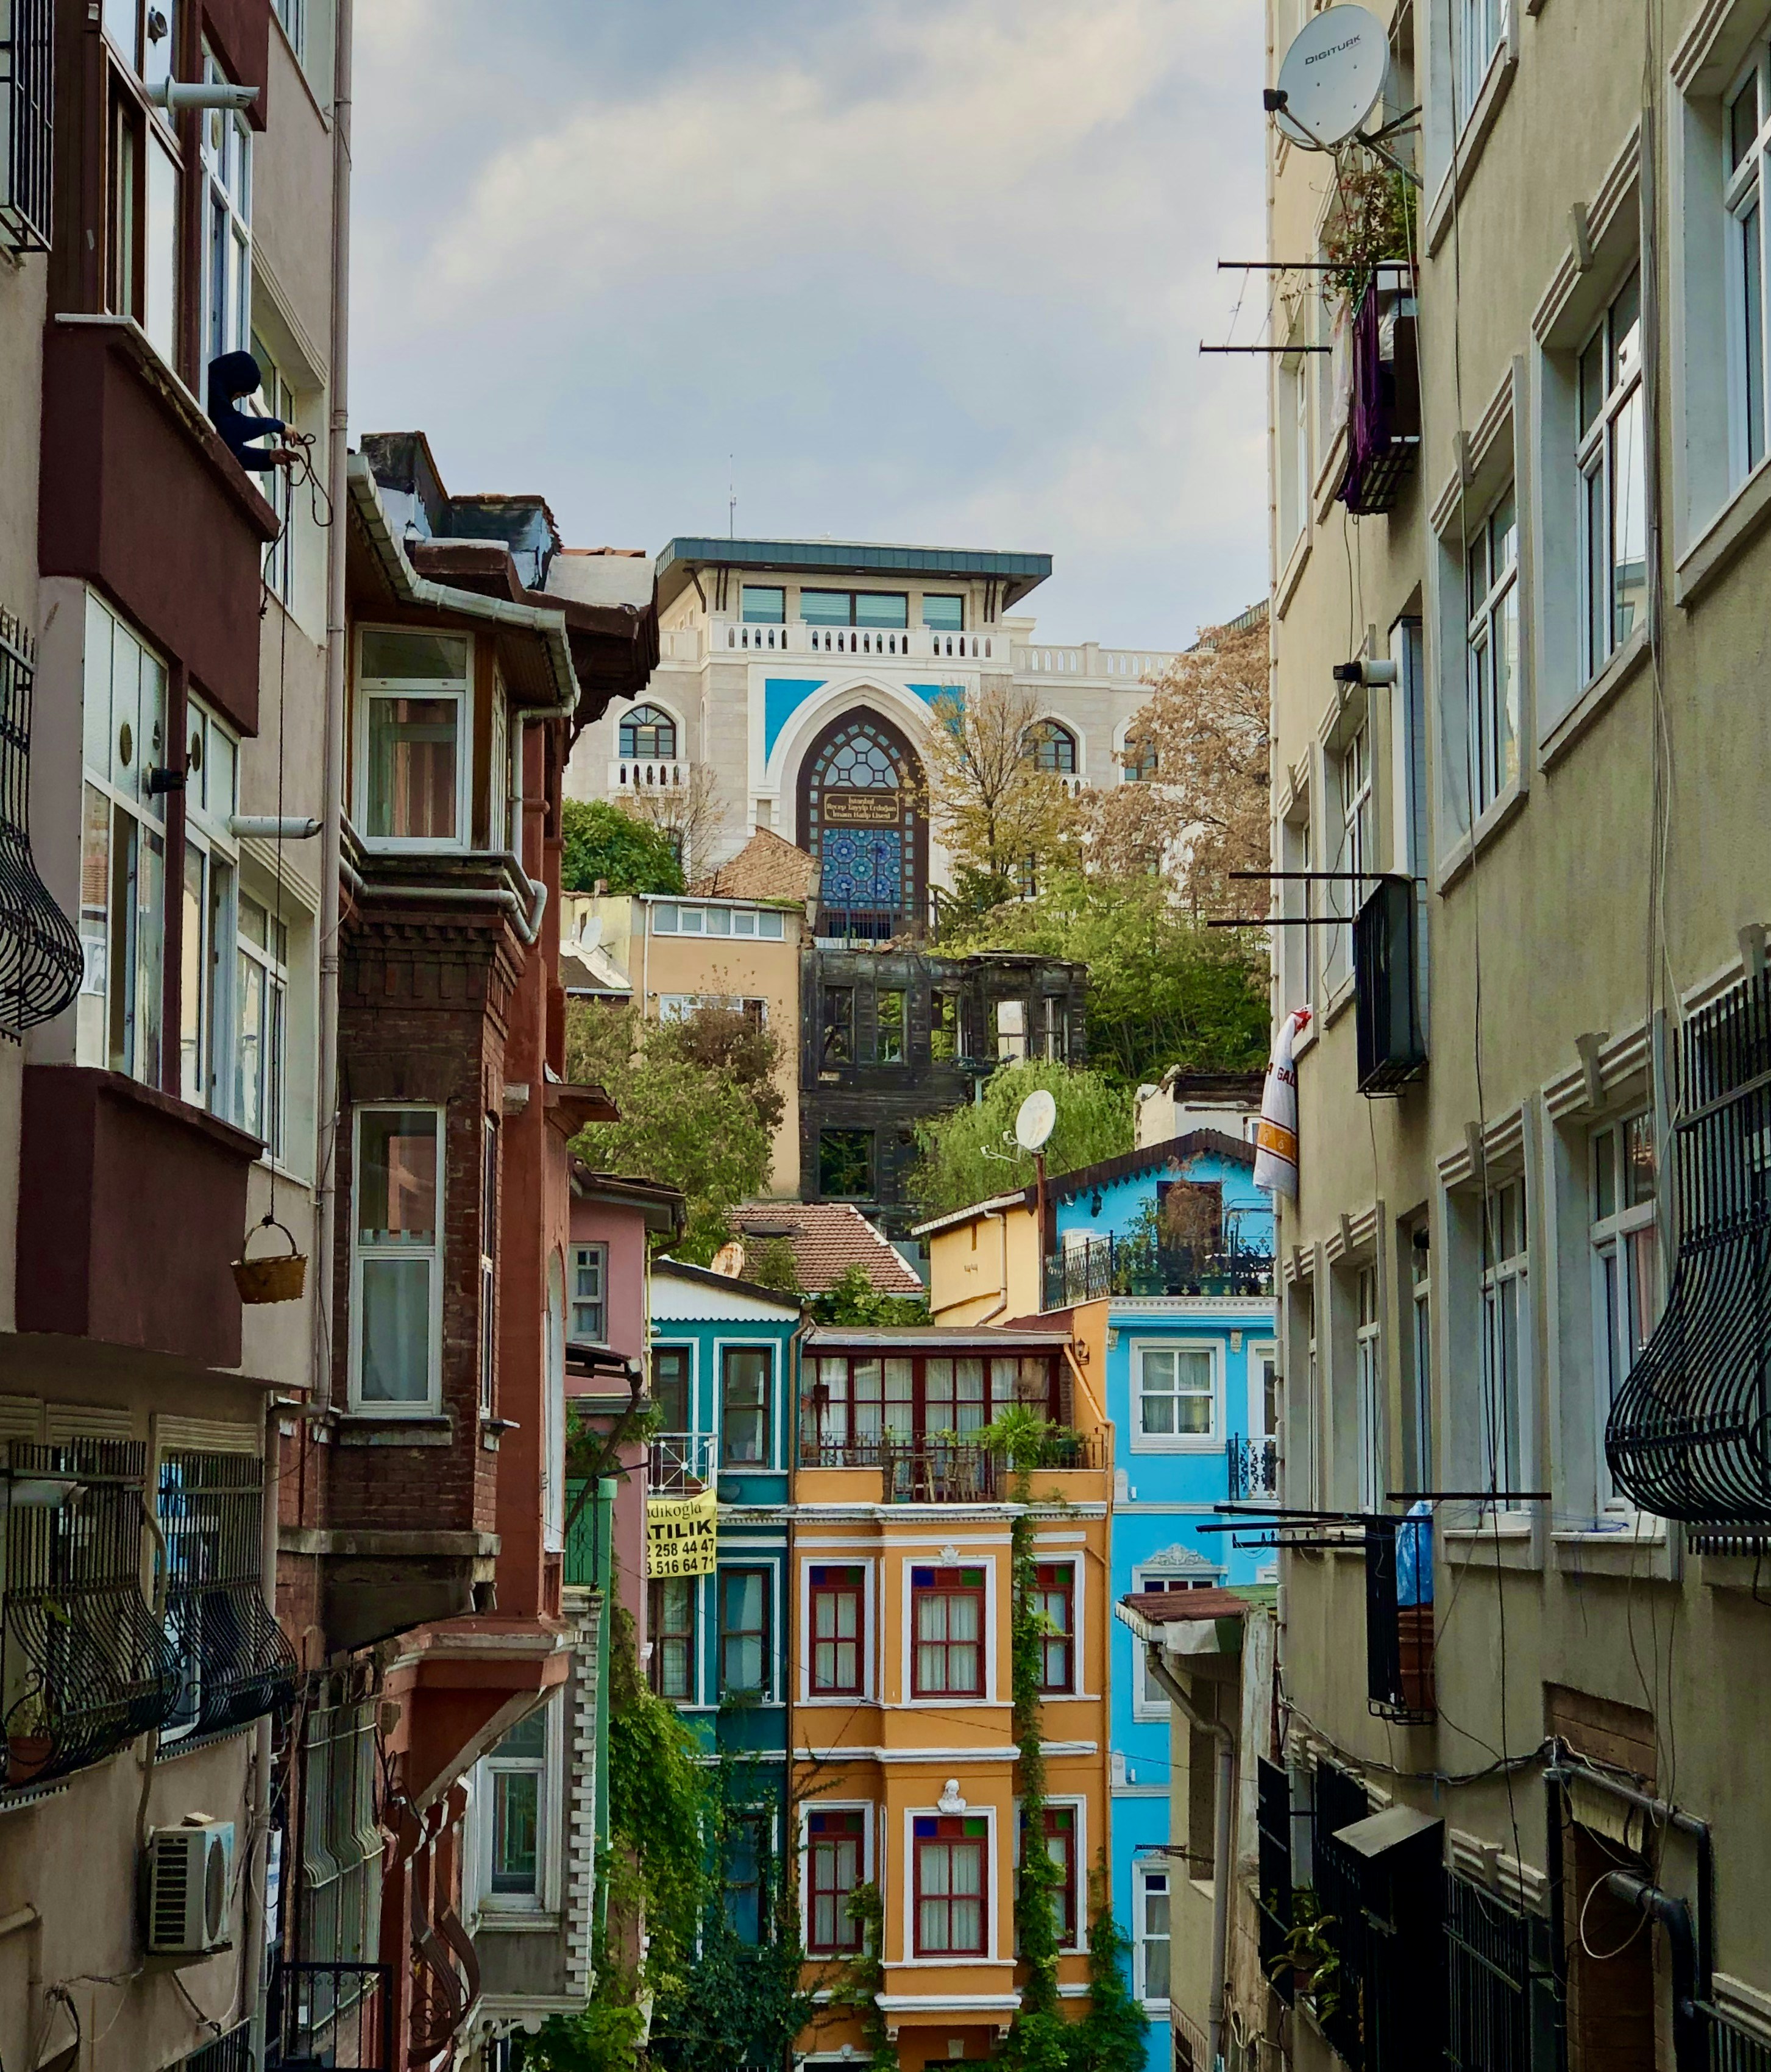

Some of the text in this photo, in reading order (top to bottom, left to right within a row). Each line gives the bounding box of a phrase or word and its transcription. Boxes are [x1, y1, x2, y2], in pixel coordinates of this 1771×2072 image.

[1305, 34, 1361, 65] DIGITURK
[655, 1543, 678, 1557] 258
[683, 1540, 698, 1554] 44
[701, 1538, 714, 1552] 47
[656, 1559, 680, 1575] 516
[683, 1558, 698, 1572] 64
[701, 1556, 714, 1570] 71
